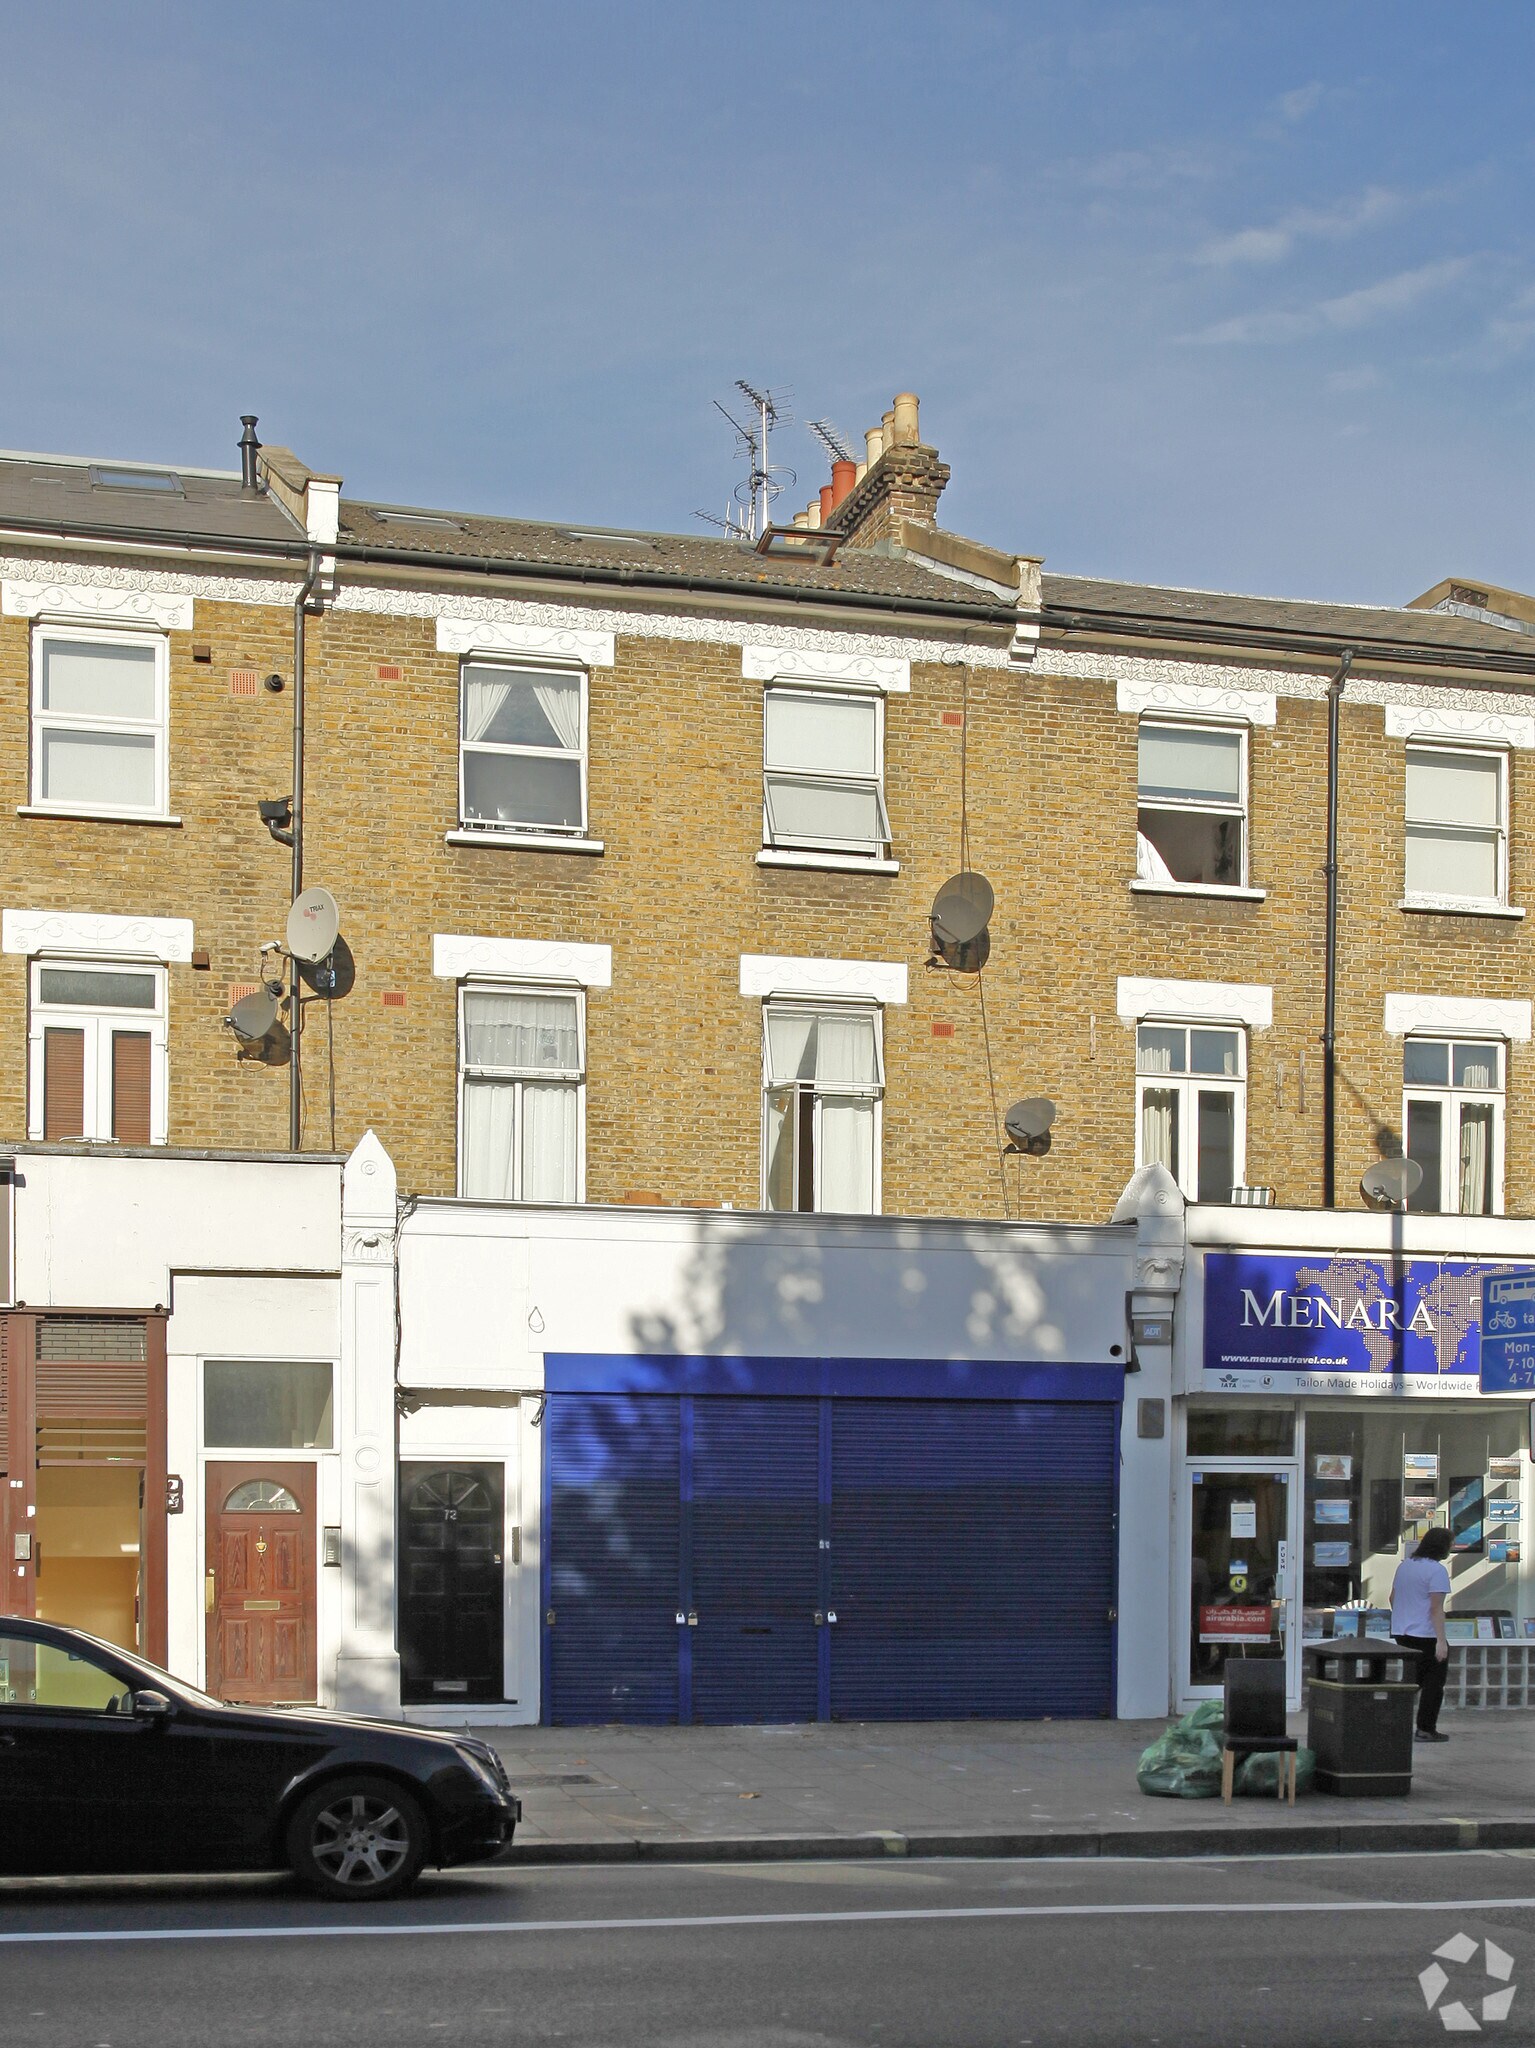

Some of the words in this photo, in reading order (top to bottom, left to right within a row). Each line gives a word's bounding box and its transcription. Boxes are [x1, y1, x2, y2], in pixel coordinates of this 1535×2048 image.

[1239, 1288, 1438, 1332] MENARA
[1144, 1327, 1160, 1336] ADT
[1221, 1355, 1349, 1365] www.menaratravel.co.uk
[1295, 1377, 1324, 1388] Tailor
[1327, 1378, 1358, 1389] Made
[1360, 1379, 1404, 1391] Holidays
[1416, 1380, 1473, 1390] Worldwide
